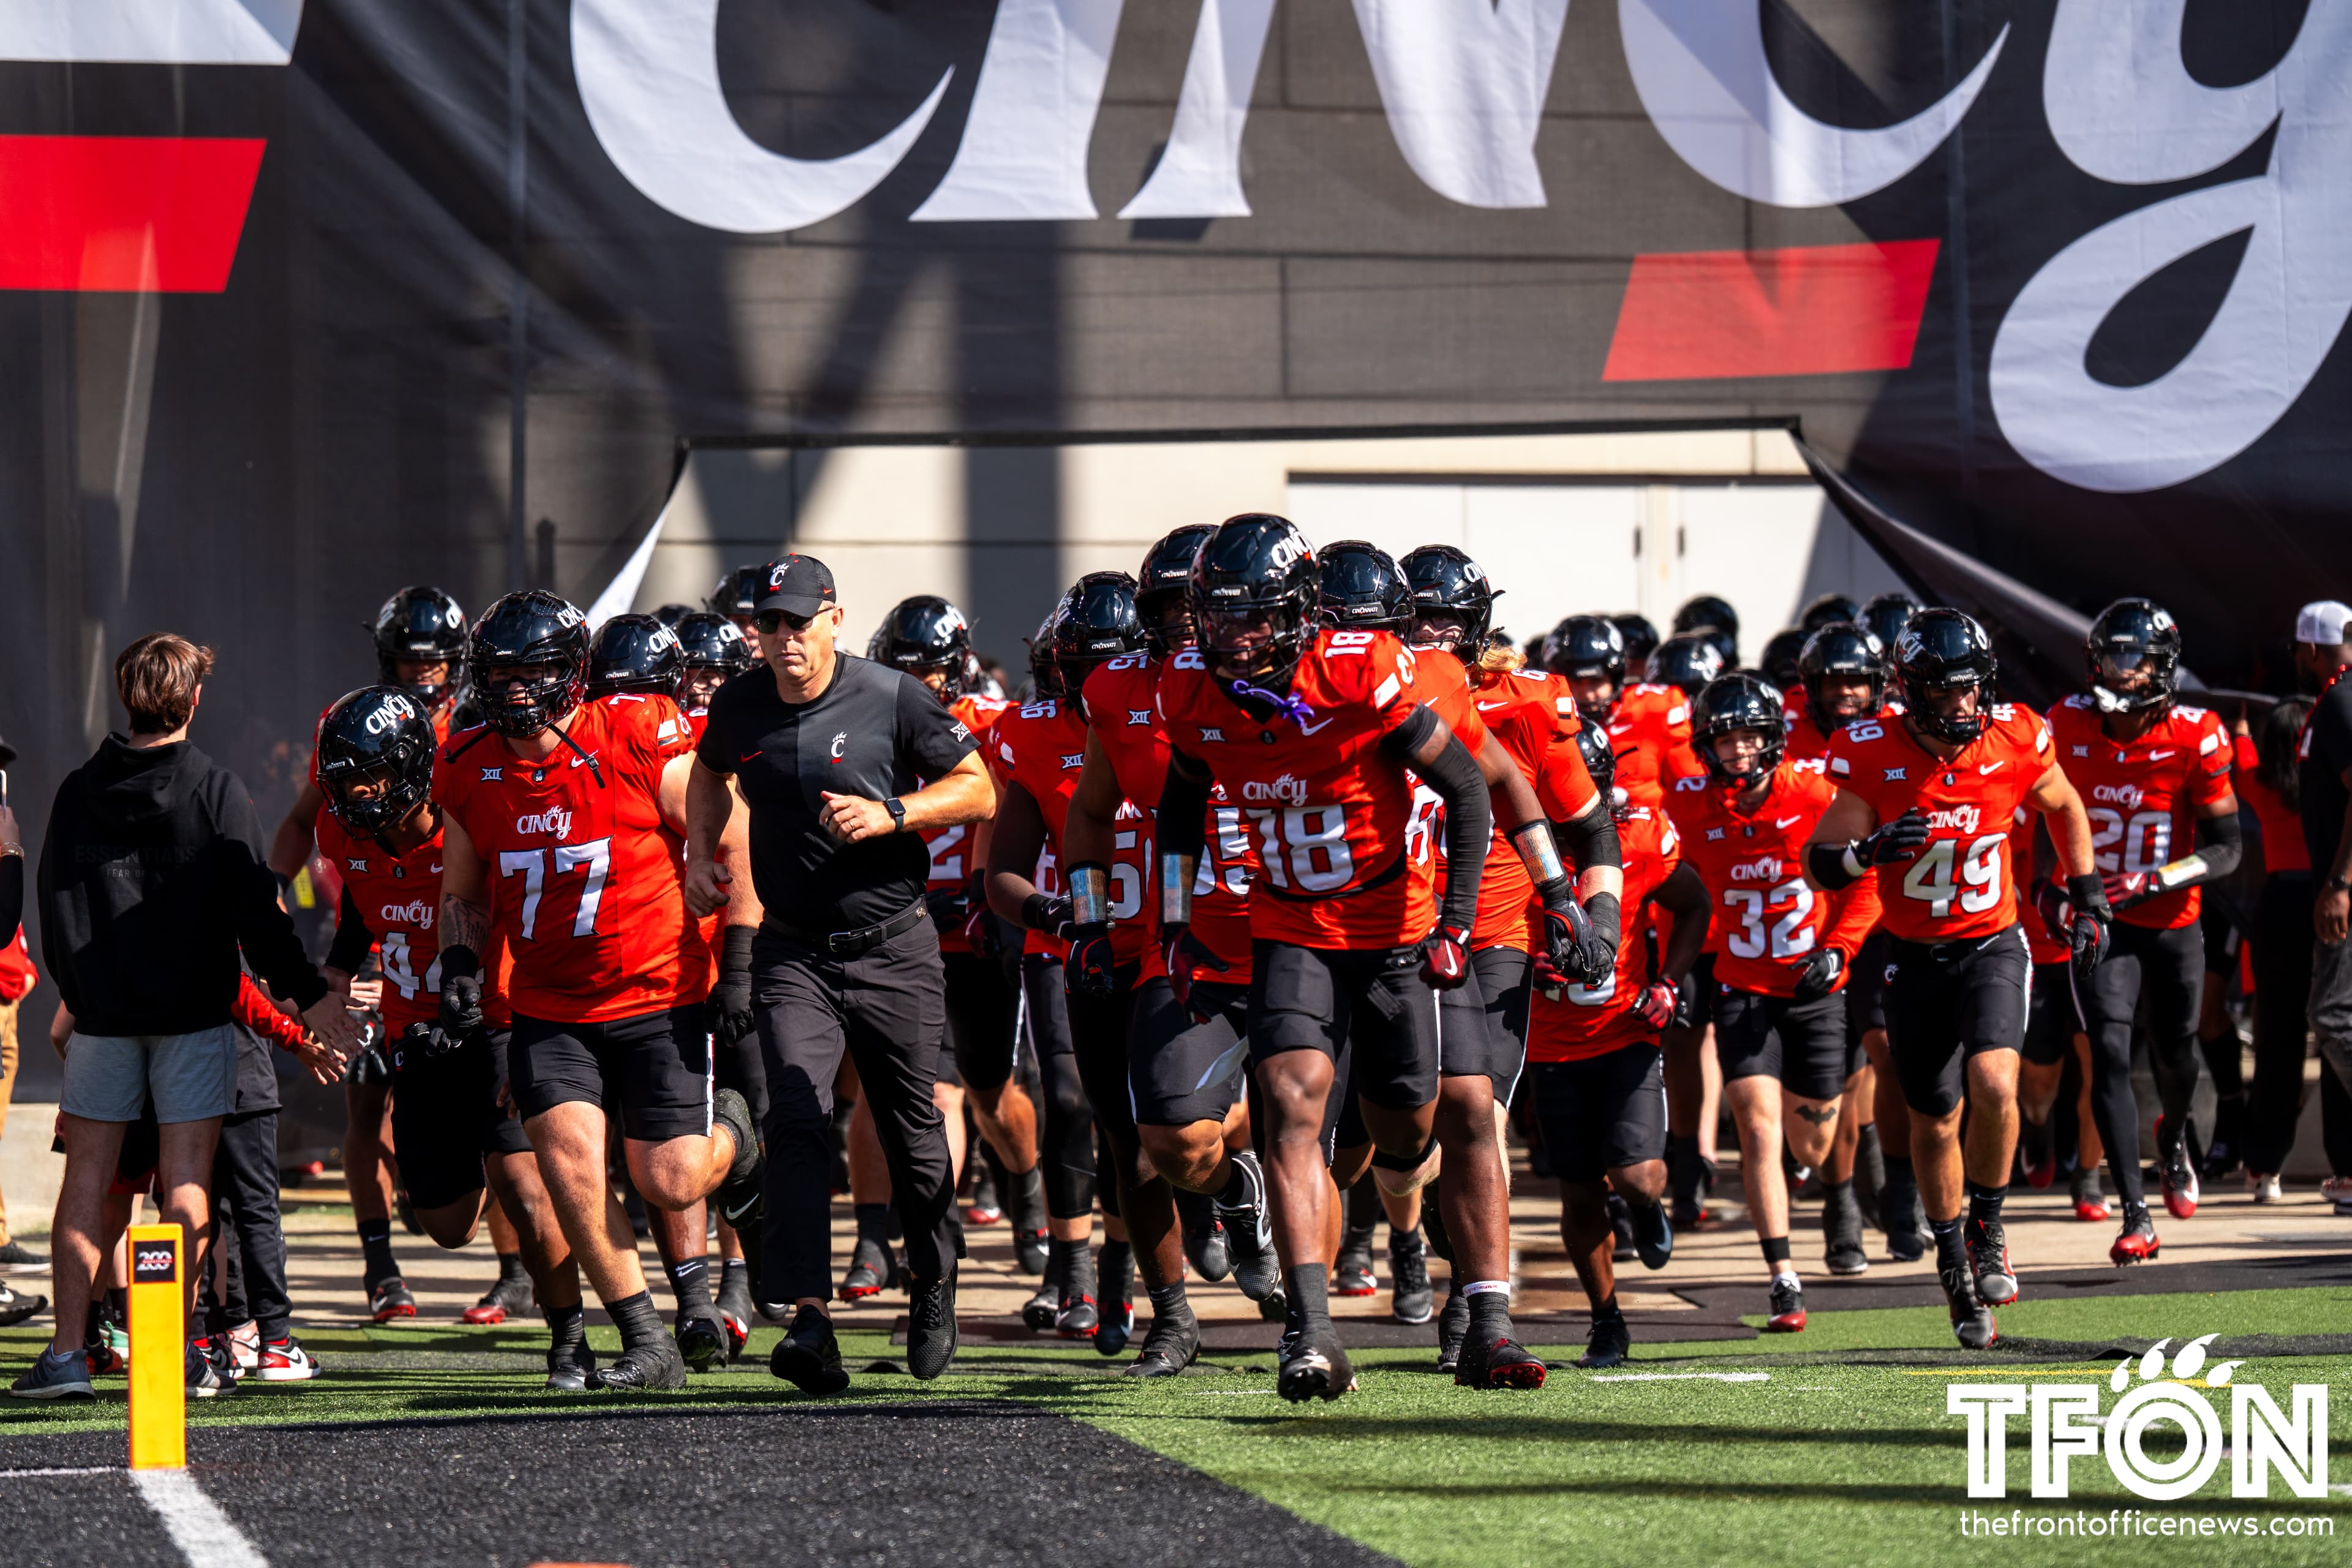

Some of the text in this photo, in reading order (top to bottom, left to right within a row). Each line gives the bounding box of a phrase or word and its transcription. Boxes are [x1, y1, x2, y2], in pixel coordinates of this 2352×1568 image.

[366, 695, 415, 735] CINCY
[481, 767, 502, 782] XII
[1243, 778, 1308, 807] CINCY
[2093, 783, 2144, 810] CINCY
[516, 810, 572, 840] CINCY
[1926, 807, 1980, 834] CINCY
[1245, 804, 1355, 892] 18
[2086, 807, 2172, 873] 20
[107, 869, 130, 878] FEAR
[1731, 859, 1783, 883] CINCY
[1904, 832, 2008, 917] 49
[499, 835, 613, 940] 77
[382, 903, 434, 930] CINCY
[1724, 878, 1815, 959] 32
